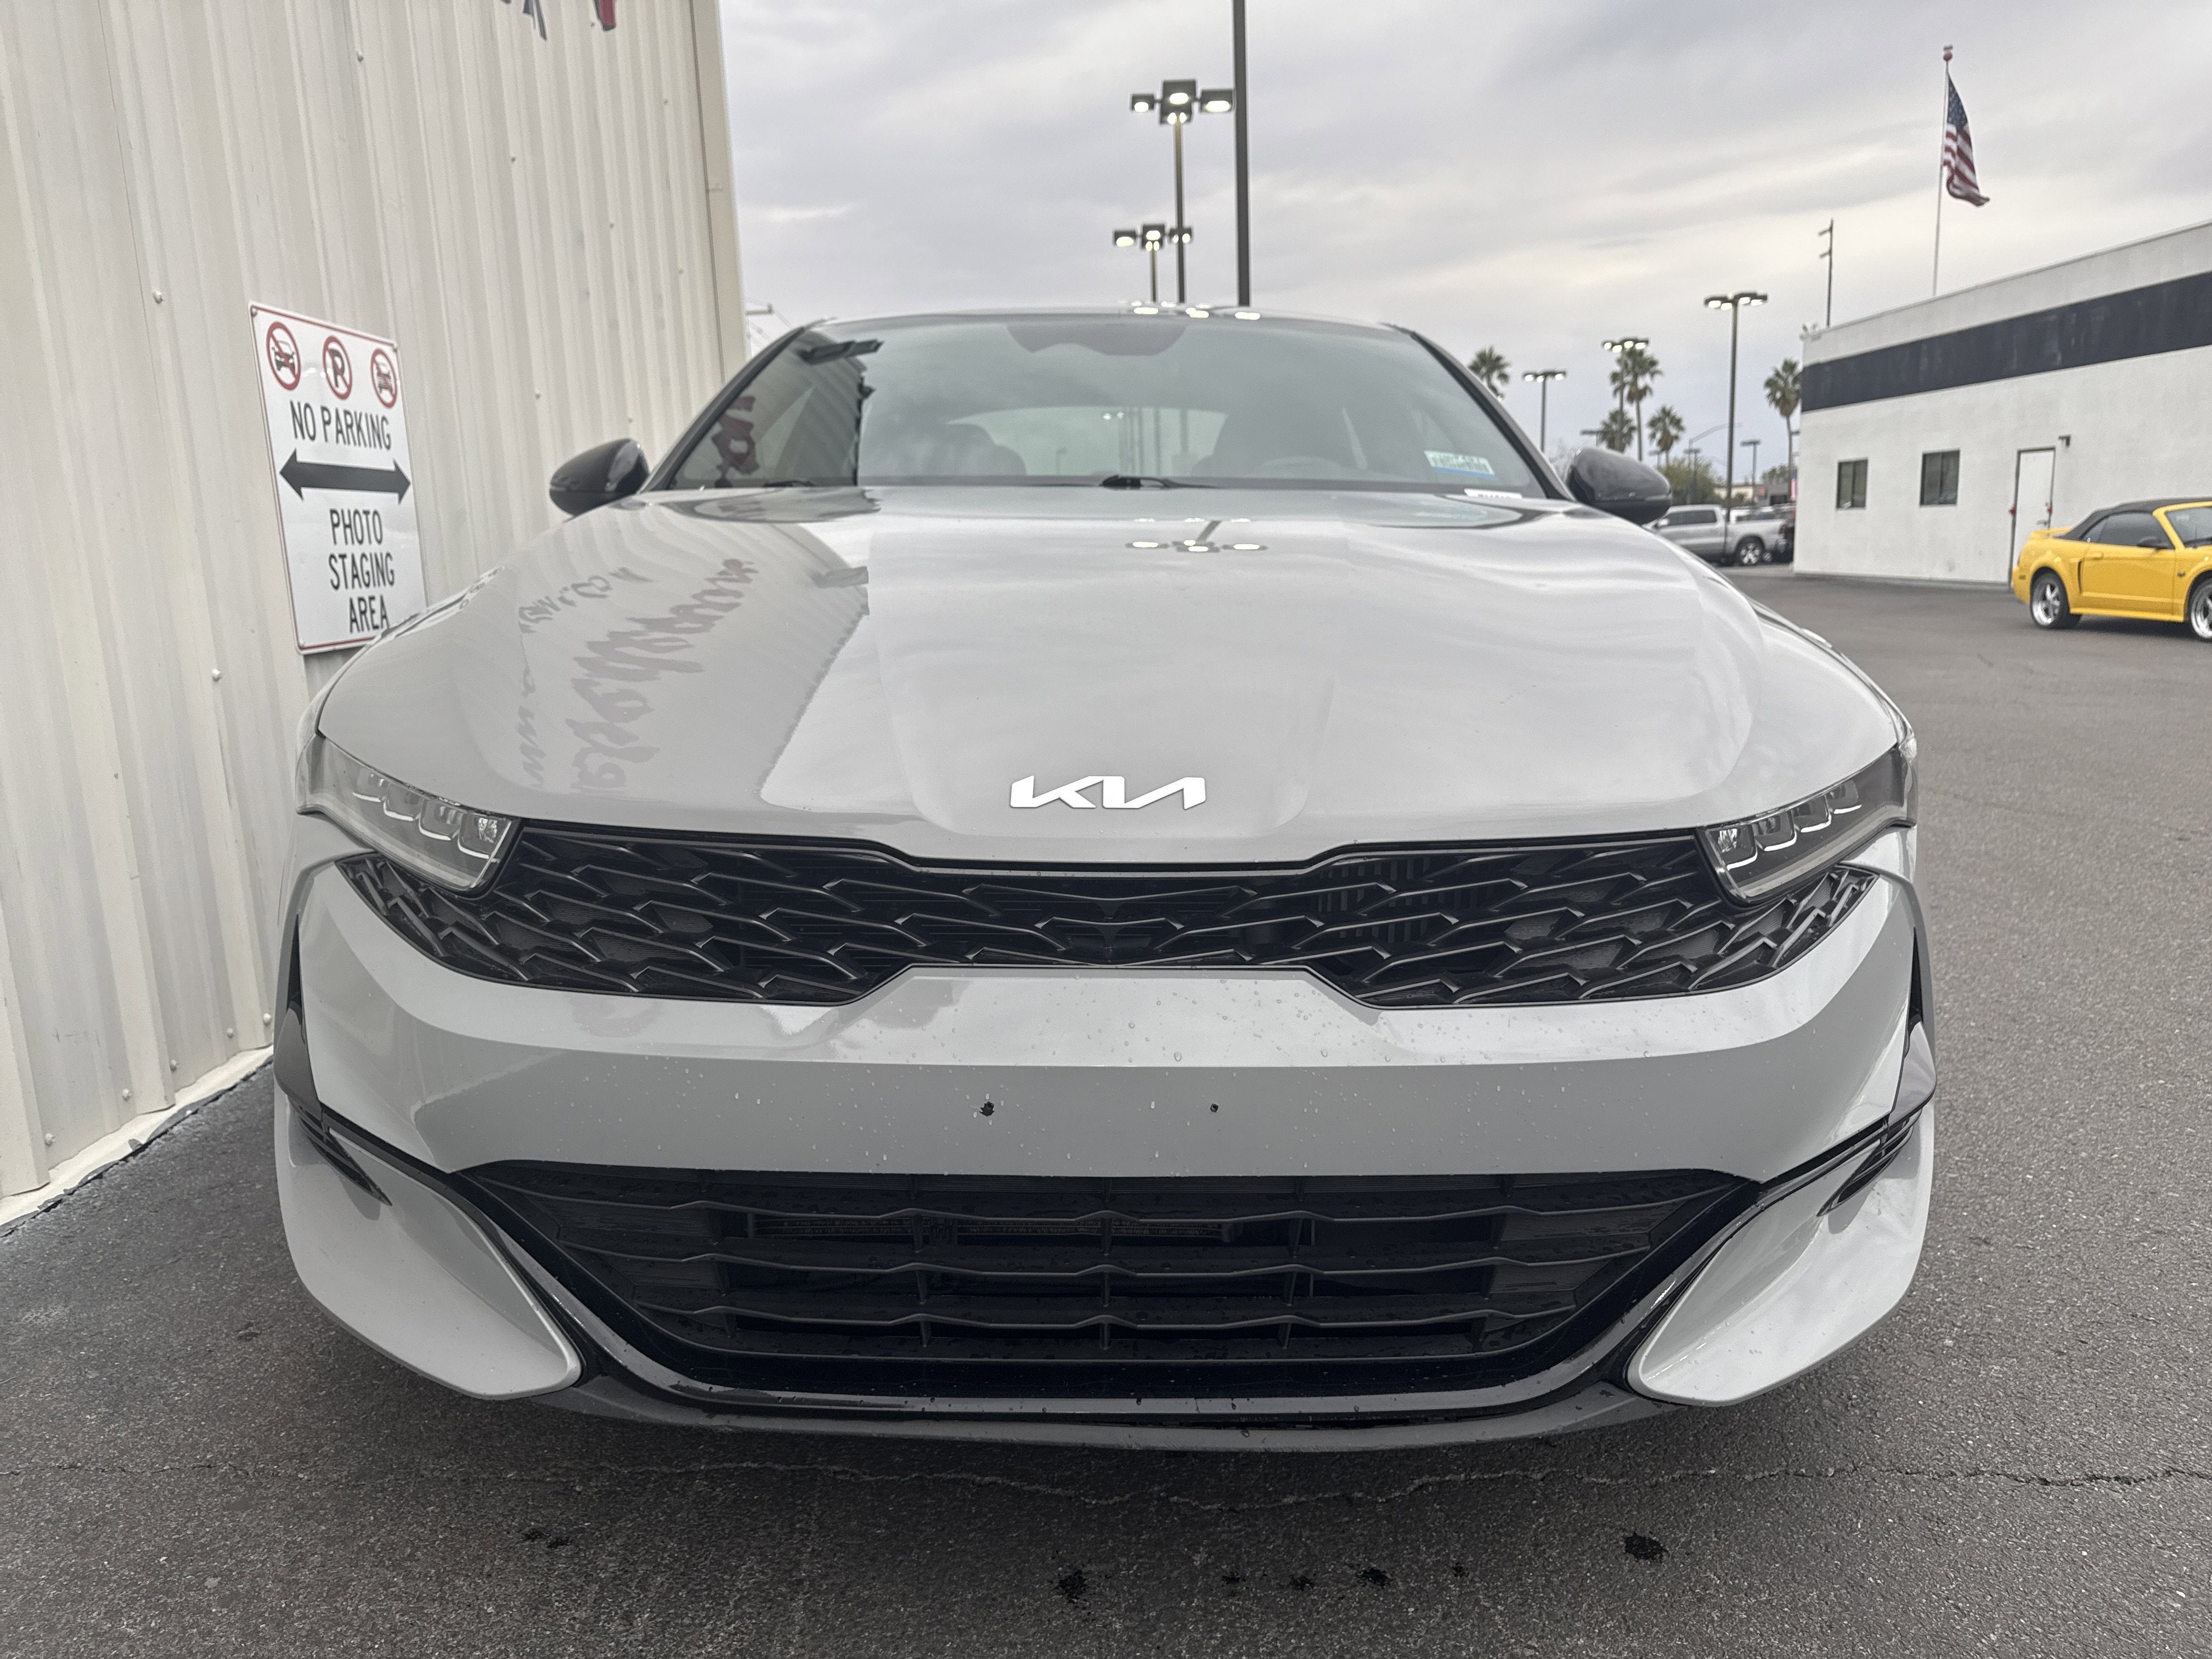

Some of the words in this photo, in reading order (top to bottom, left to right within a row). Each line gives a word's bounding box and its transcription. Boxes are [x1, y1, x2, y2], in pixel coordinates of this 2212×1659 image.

[290, 399, 316, 442] NO
[320, 405, 391, 450] PARKING
[329, 508, 383, 545] PHOTO
[329, 551, 395, 590] STAGING
[349, 594, 390, 634] AREA
[1010, 775, 1206, 810] KIA
